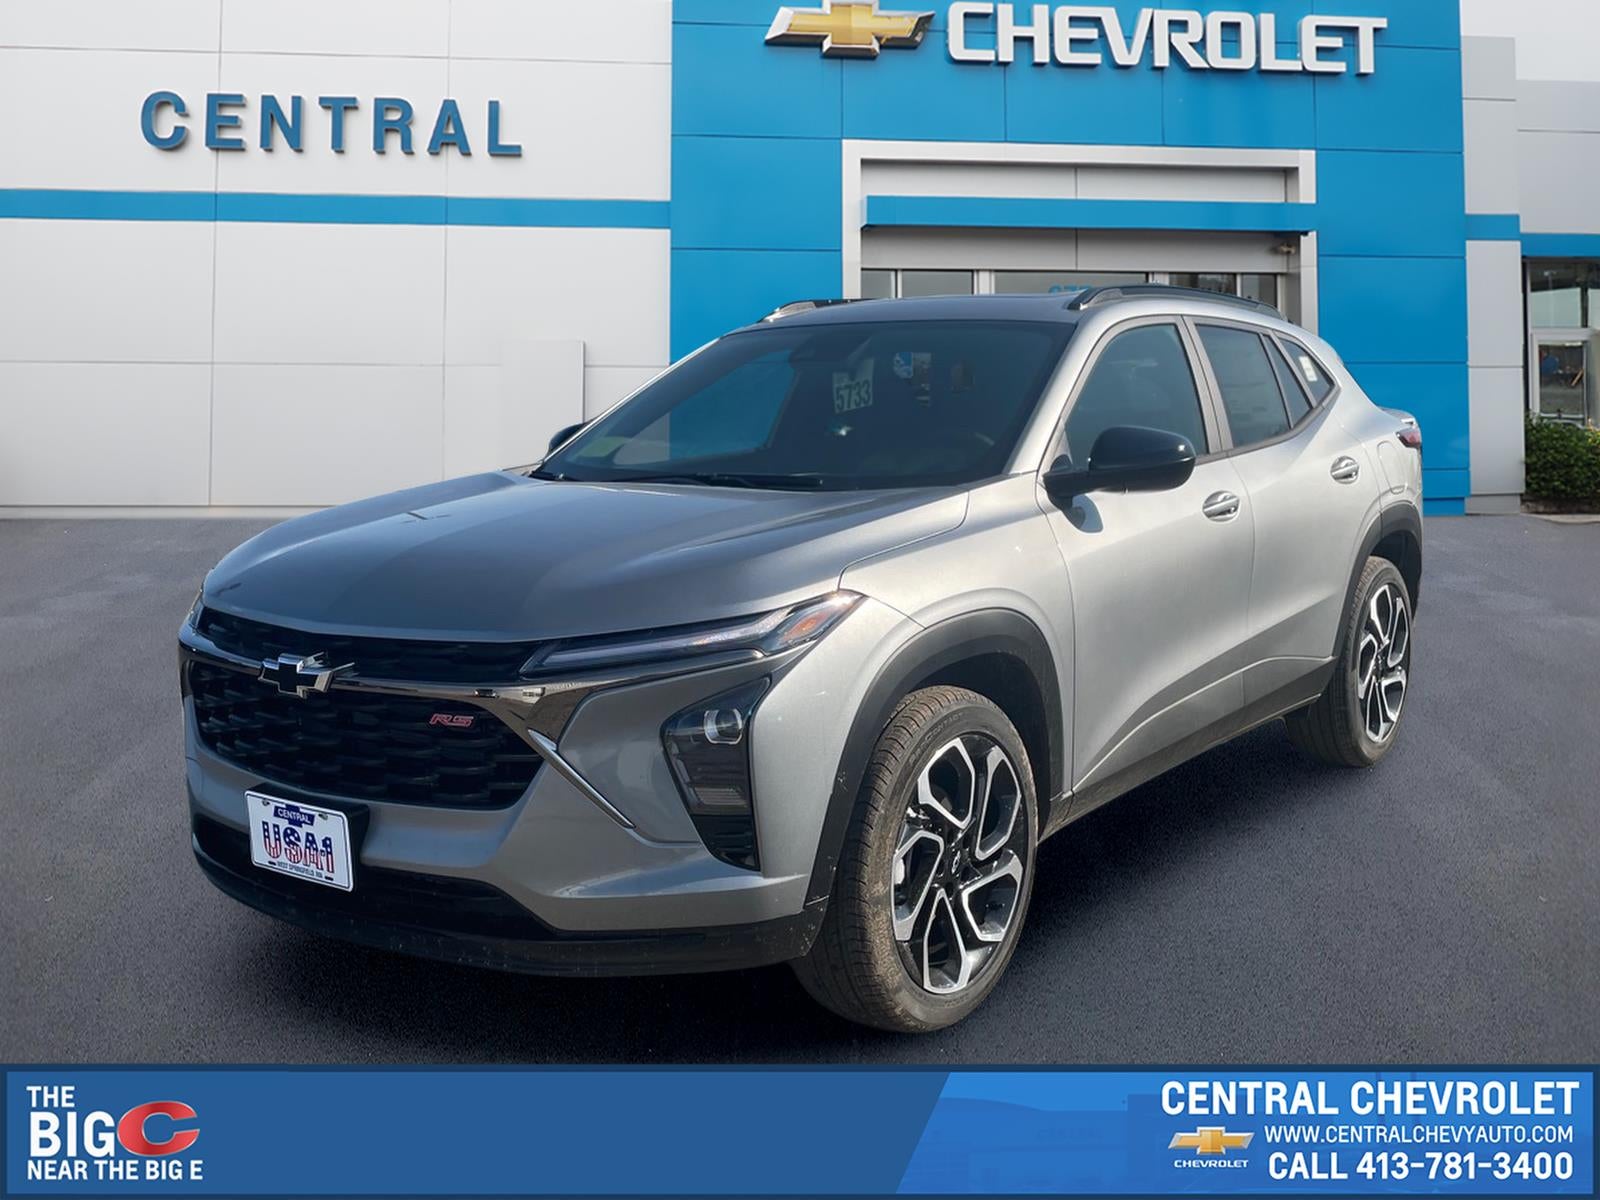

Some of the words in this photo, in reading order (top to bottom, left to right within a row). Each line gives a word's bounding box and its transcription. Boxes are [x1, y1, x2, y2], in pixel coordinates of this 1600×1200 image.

[947, 1, 1388, 75] CHEVROLET
[141, 91, 522, 157] CENTRAL
[835, 379, 870, 411] 5733
[429, 713, 474, 727] RS
[277, 807, 311, 824] CENTRAL
